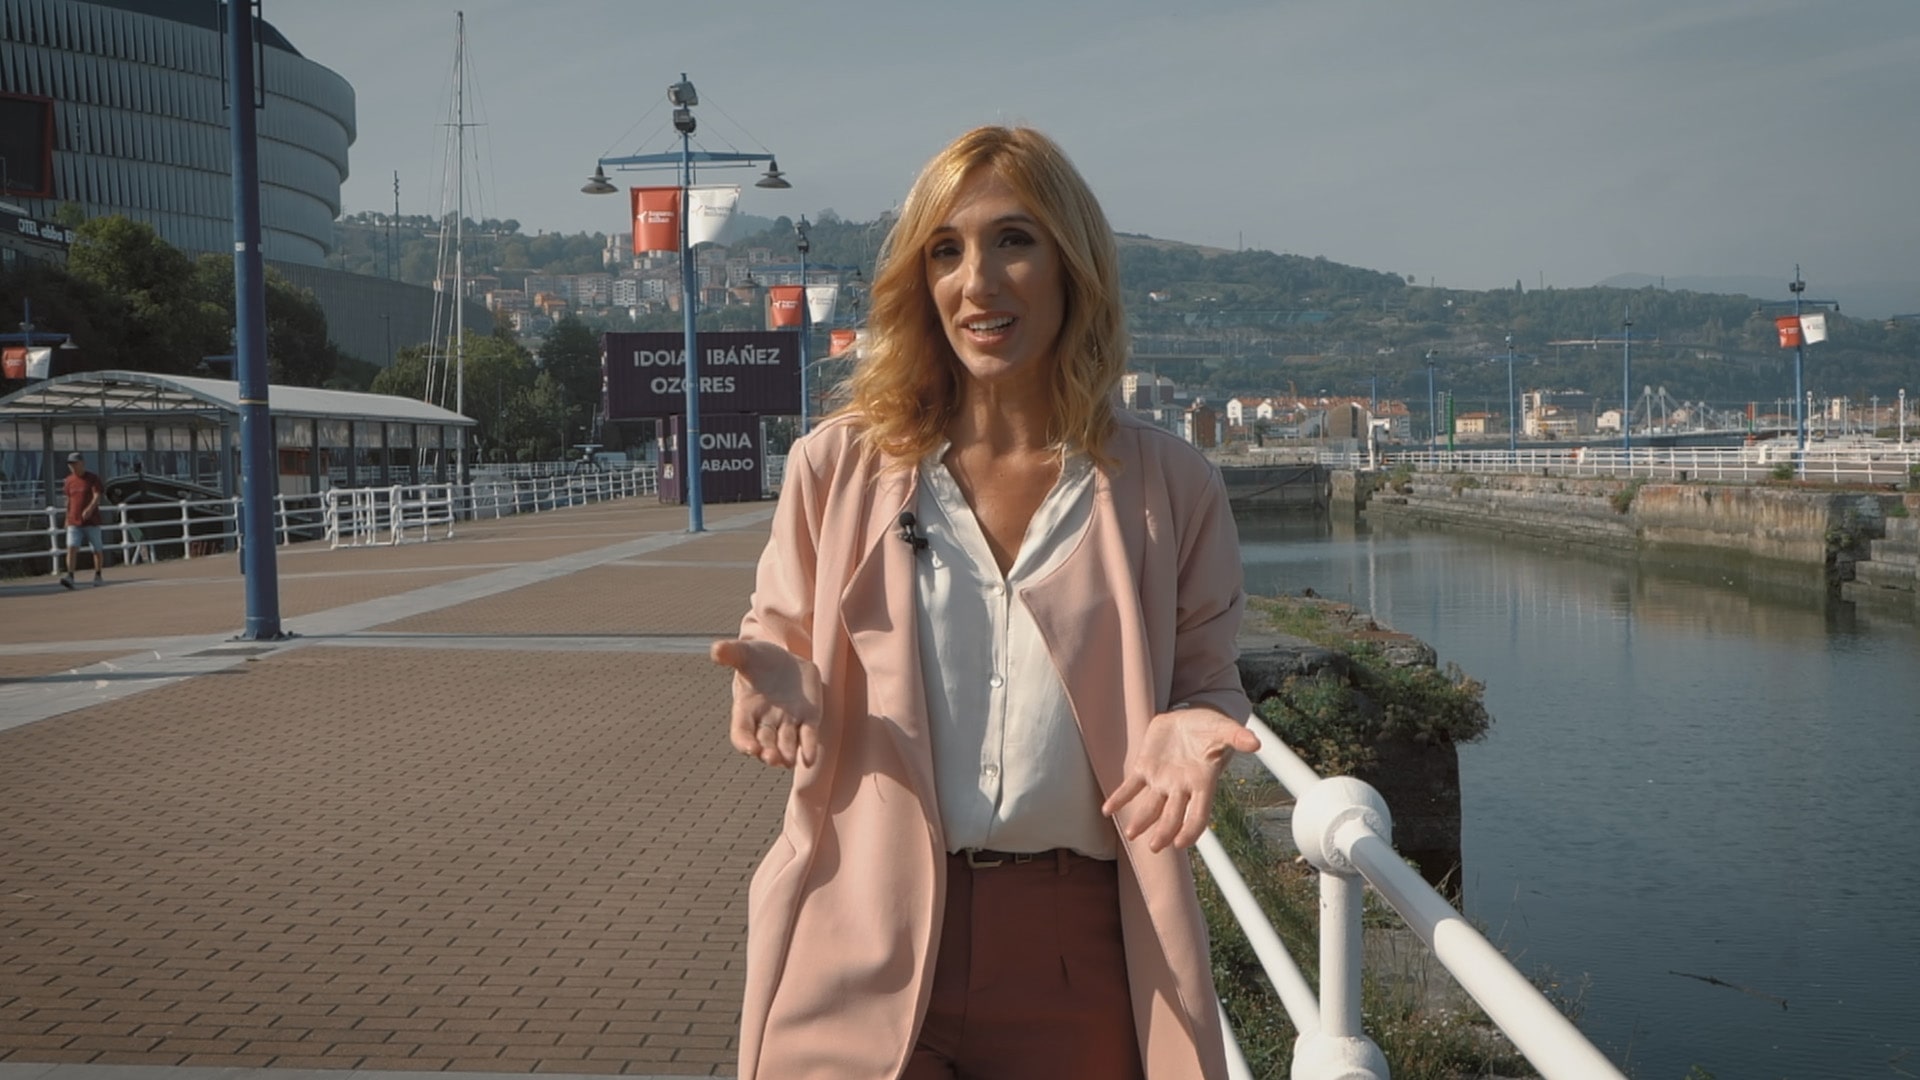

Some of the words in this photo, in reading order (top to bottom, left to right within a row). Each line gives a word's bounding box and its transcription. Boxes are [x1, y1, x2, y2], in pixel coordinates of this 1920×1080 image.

[18, 218, 38, 236] OTEL
[633, 350, 687, 367] IDOIA
[706, 344, 781, 365] IBÁÑEZ
[700, 432, 753, 450] ONIA
[701, 458, 754, 472] ABADO
